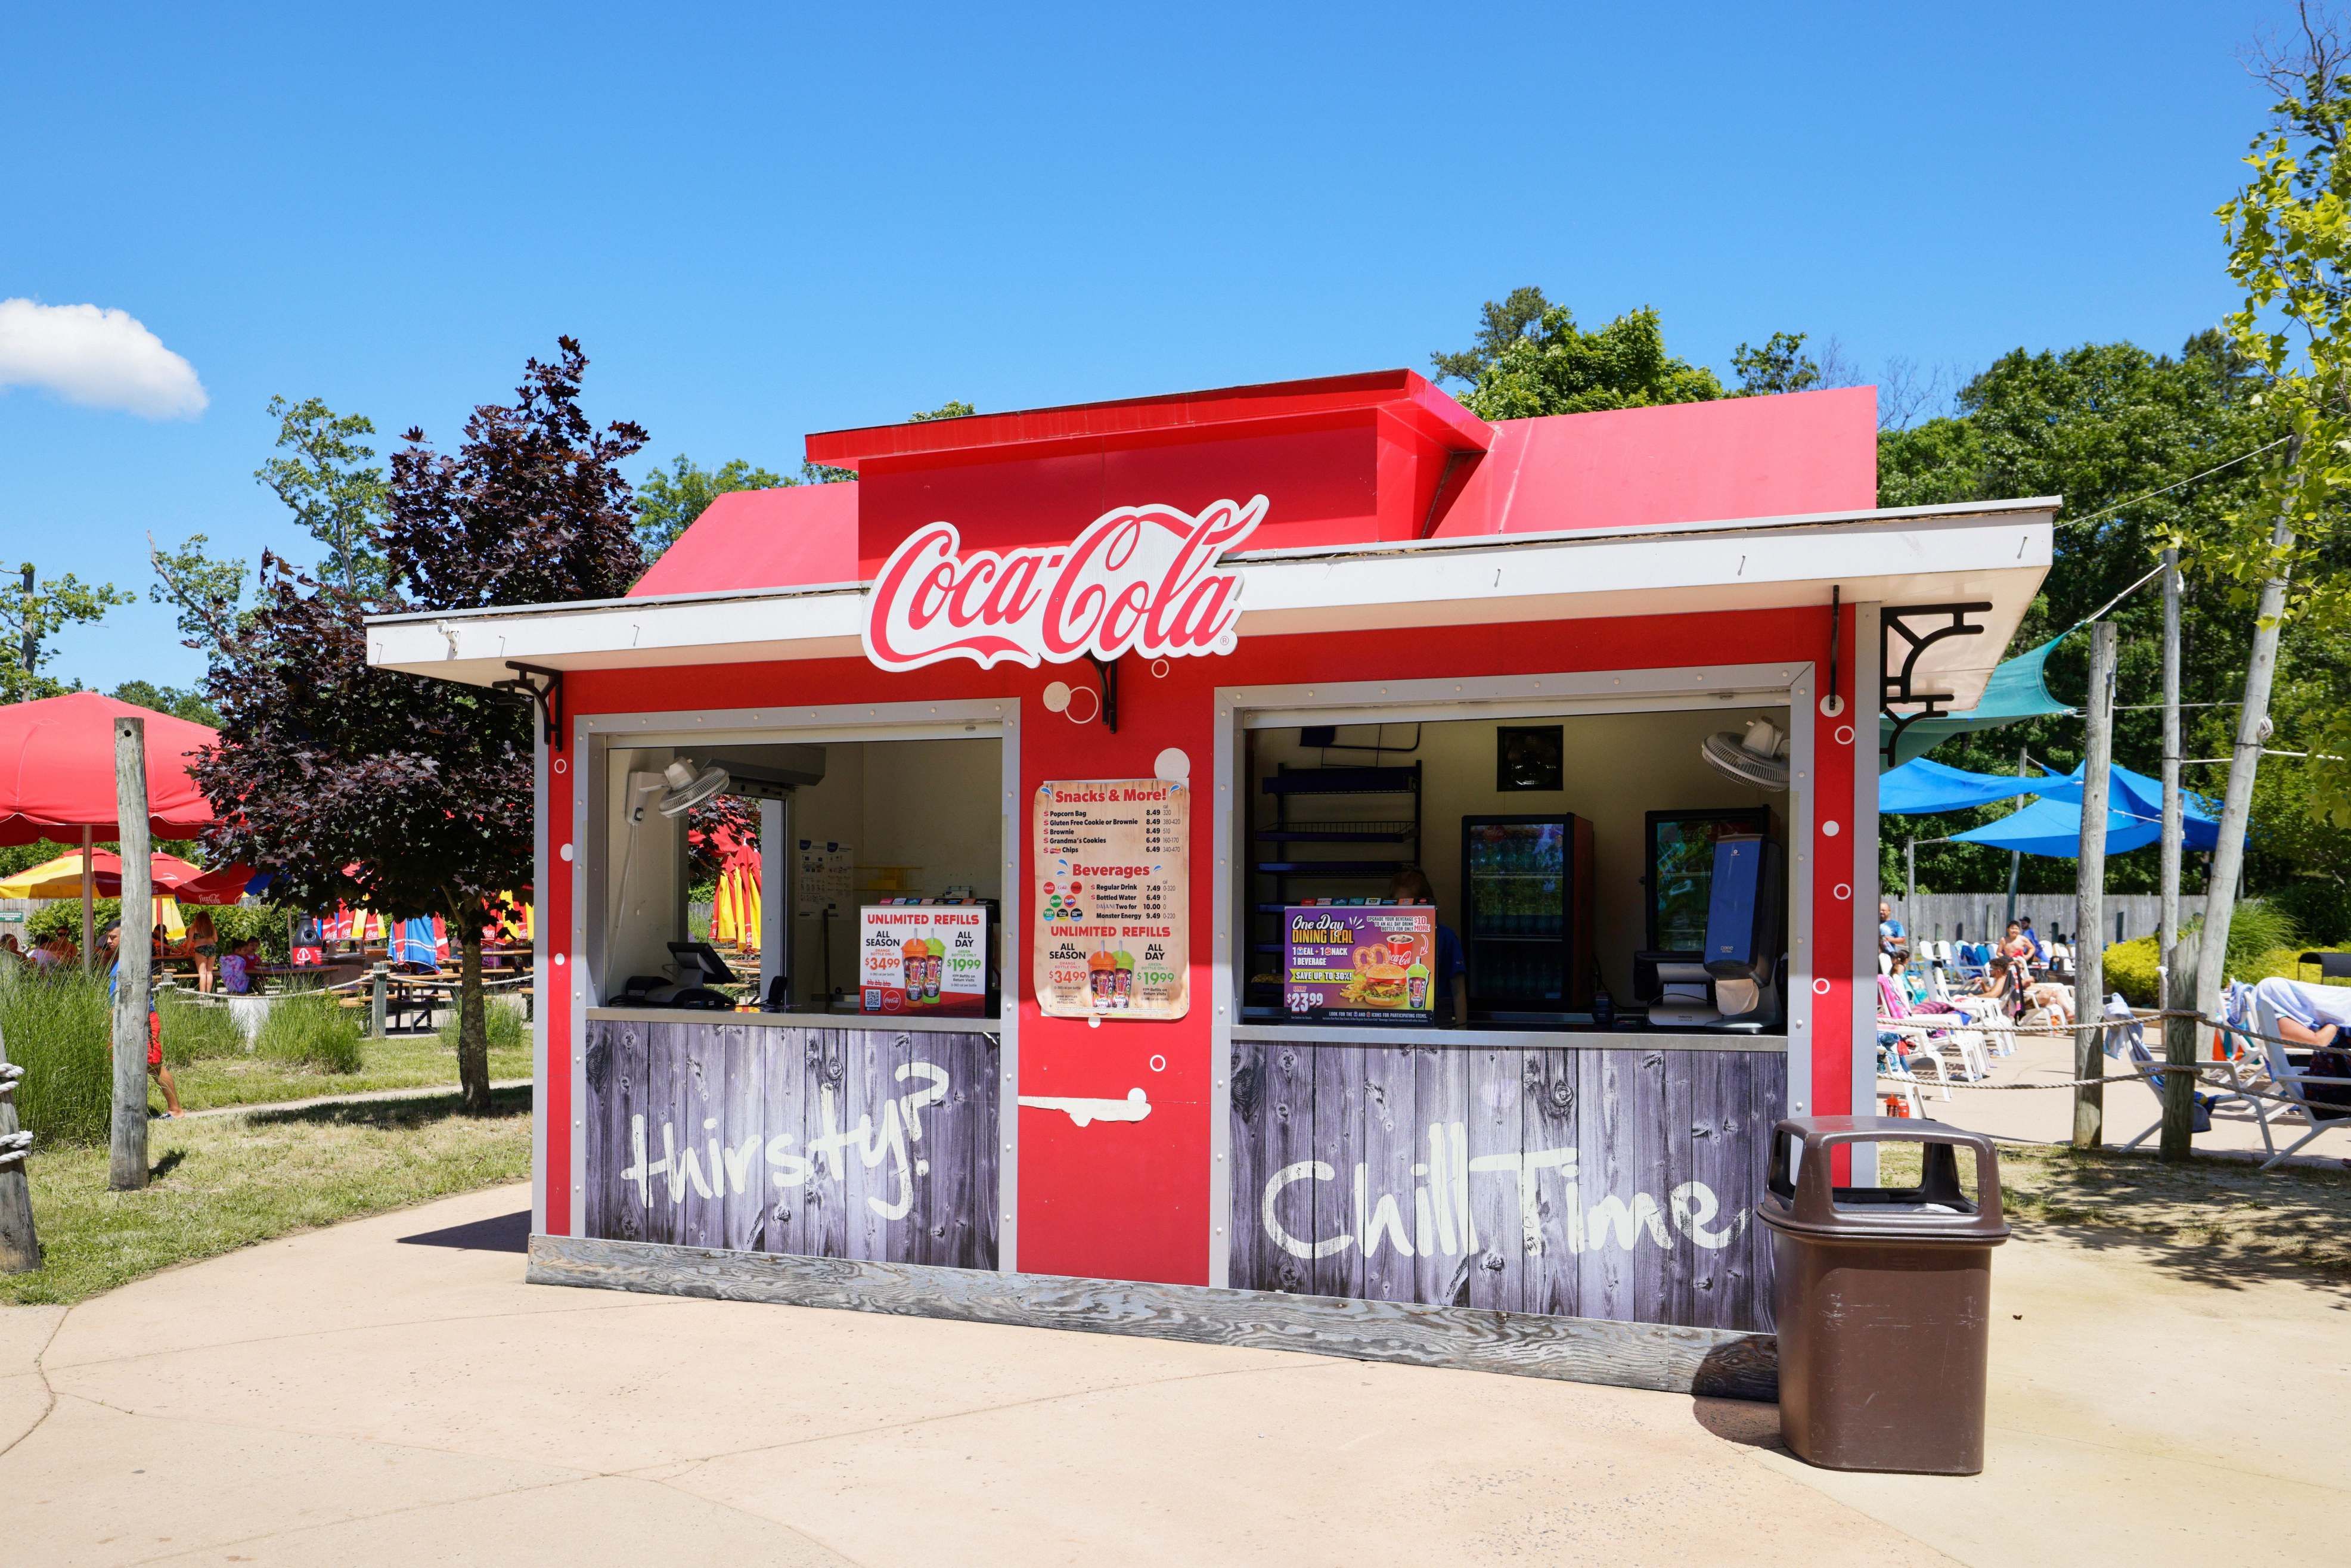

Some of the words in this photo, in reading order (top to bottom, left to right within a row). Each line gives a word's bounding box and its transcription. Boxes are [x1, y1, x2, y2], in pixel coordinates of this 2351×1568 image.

[870, 504, 1260, 663] Coca-Cola
[1055, 790, 1105, 803] Snacks
[1108, 789, 1120, 802] &
[1124, 788, 1167, 802] More!
[1073, 864, 1150, 878] Beverages
[867, 914, 929, 924] UNLIMITED
[934, 915, 979, 925] REFILLS
[1292, 915, 1314, 930] One
[1316, 914, 1344, 937] Day
[1051, 927, 1116, 936] UNLIMITED
[1122, 927, 1171, 937] REFILLS
[1292, 930, 1327, 943] DINING
[1330, 930, 1354, 943] DEAL
[1263, 1121, 1480, 1259] Chill
[1469, 1147, 1754, 1256] Time
